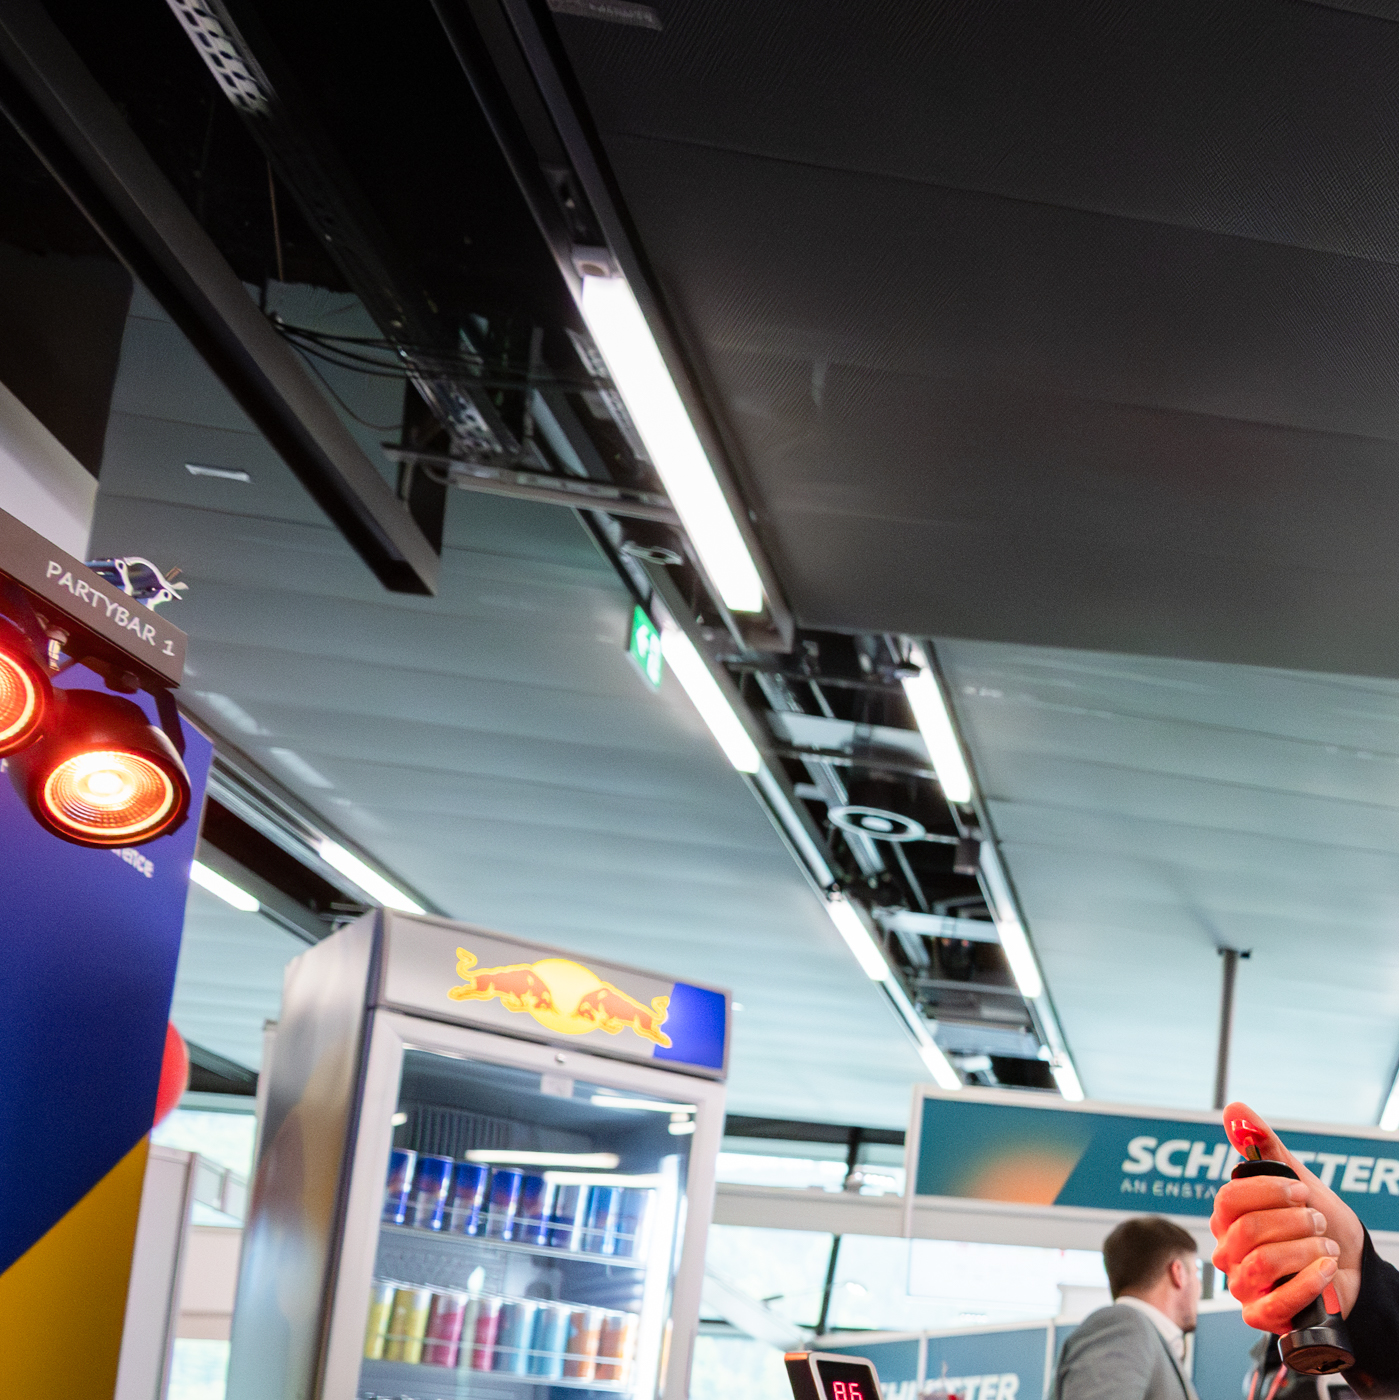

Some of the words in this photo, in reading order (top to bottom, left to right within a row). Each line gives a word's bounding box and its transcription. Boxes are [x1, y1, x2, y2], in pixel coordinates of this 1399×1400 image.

[46, 560, 156, 646] PARTYBAR
[162, 639, 175, 657] 1
[1151, 1180, 1217, 1200] ENSTA
